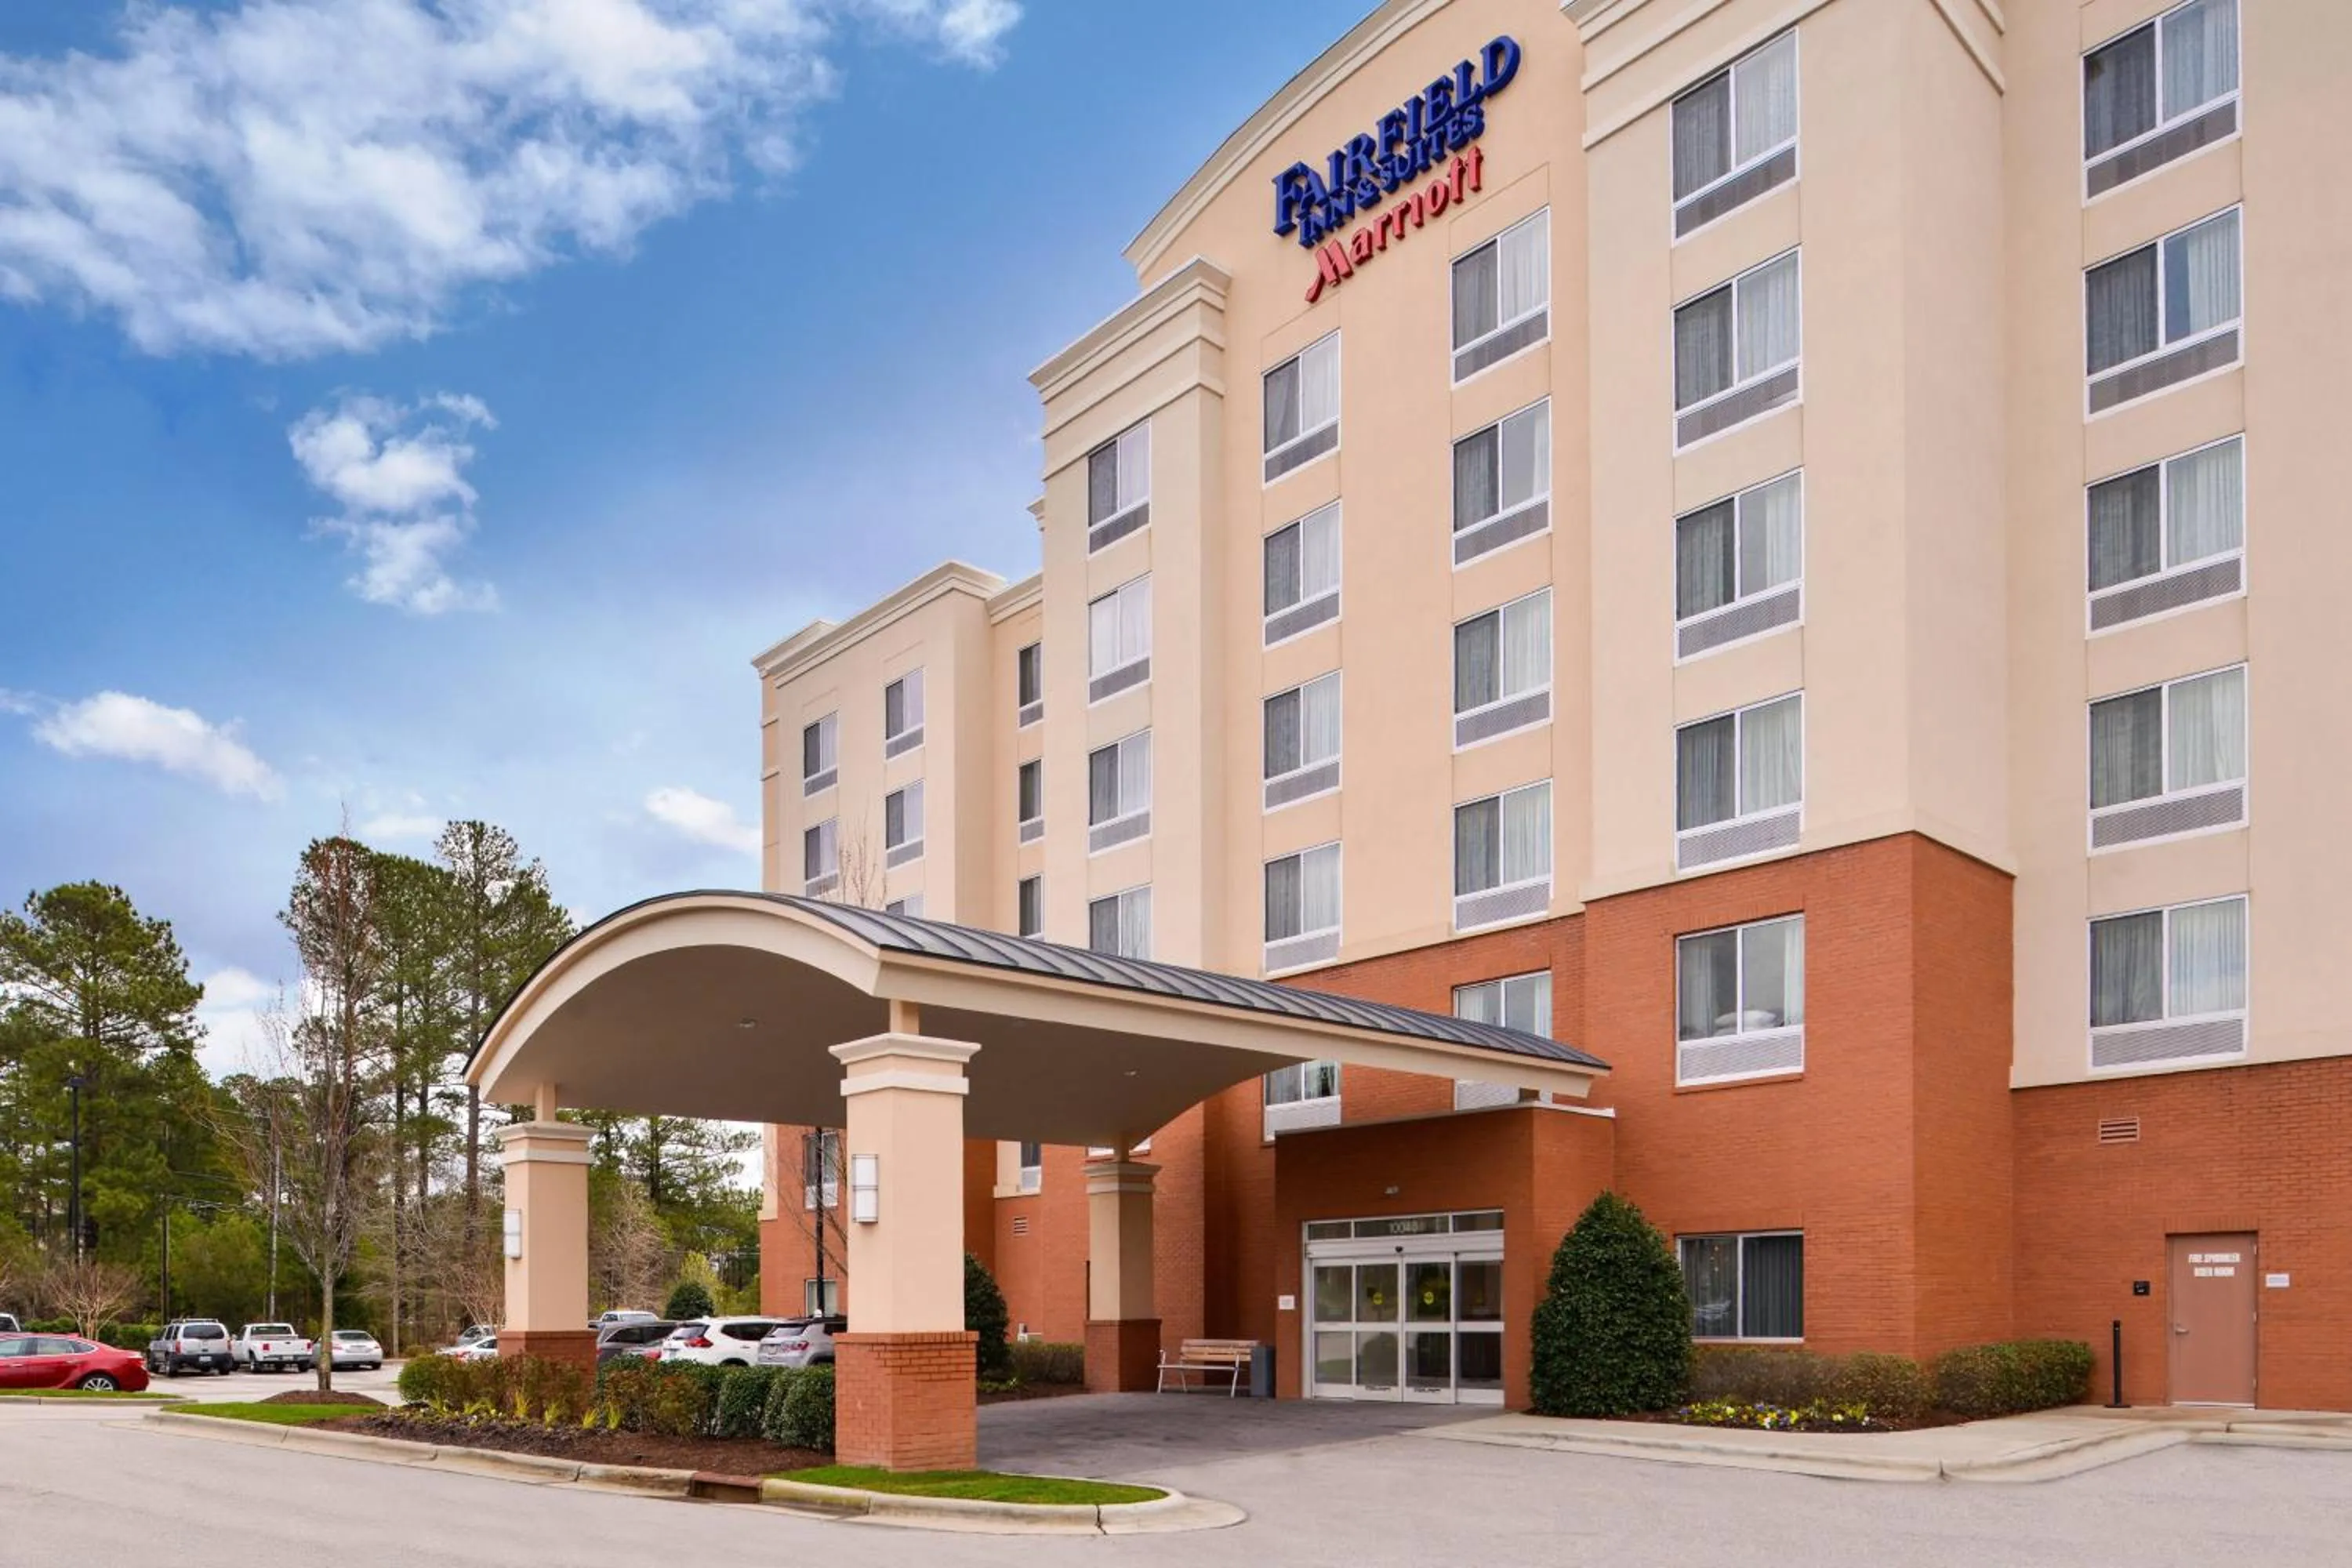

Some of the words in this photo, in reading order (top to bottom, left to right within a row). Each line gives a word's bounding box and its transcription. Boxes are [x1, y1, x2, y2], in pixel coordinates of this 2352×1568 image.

[1272, 35, 1520, 236] FAIRFIELD
[1354, 176, 1382, 211] &
[1379, 103, 1485, 195] SUITES
[1305, 146, 1483, 303] Marriott
